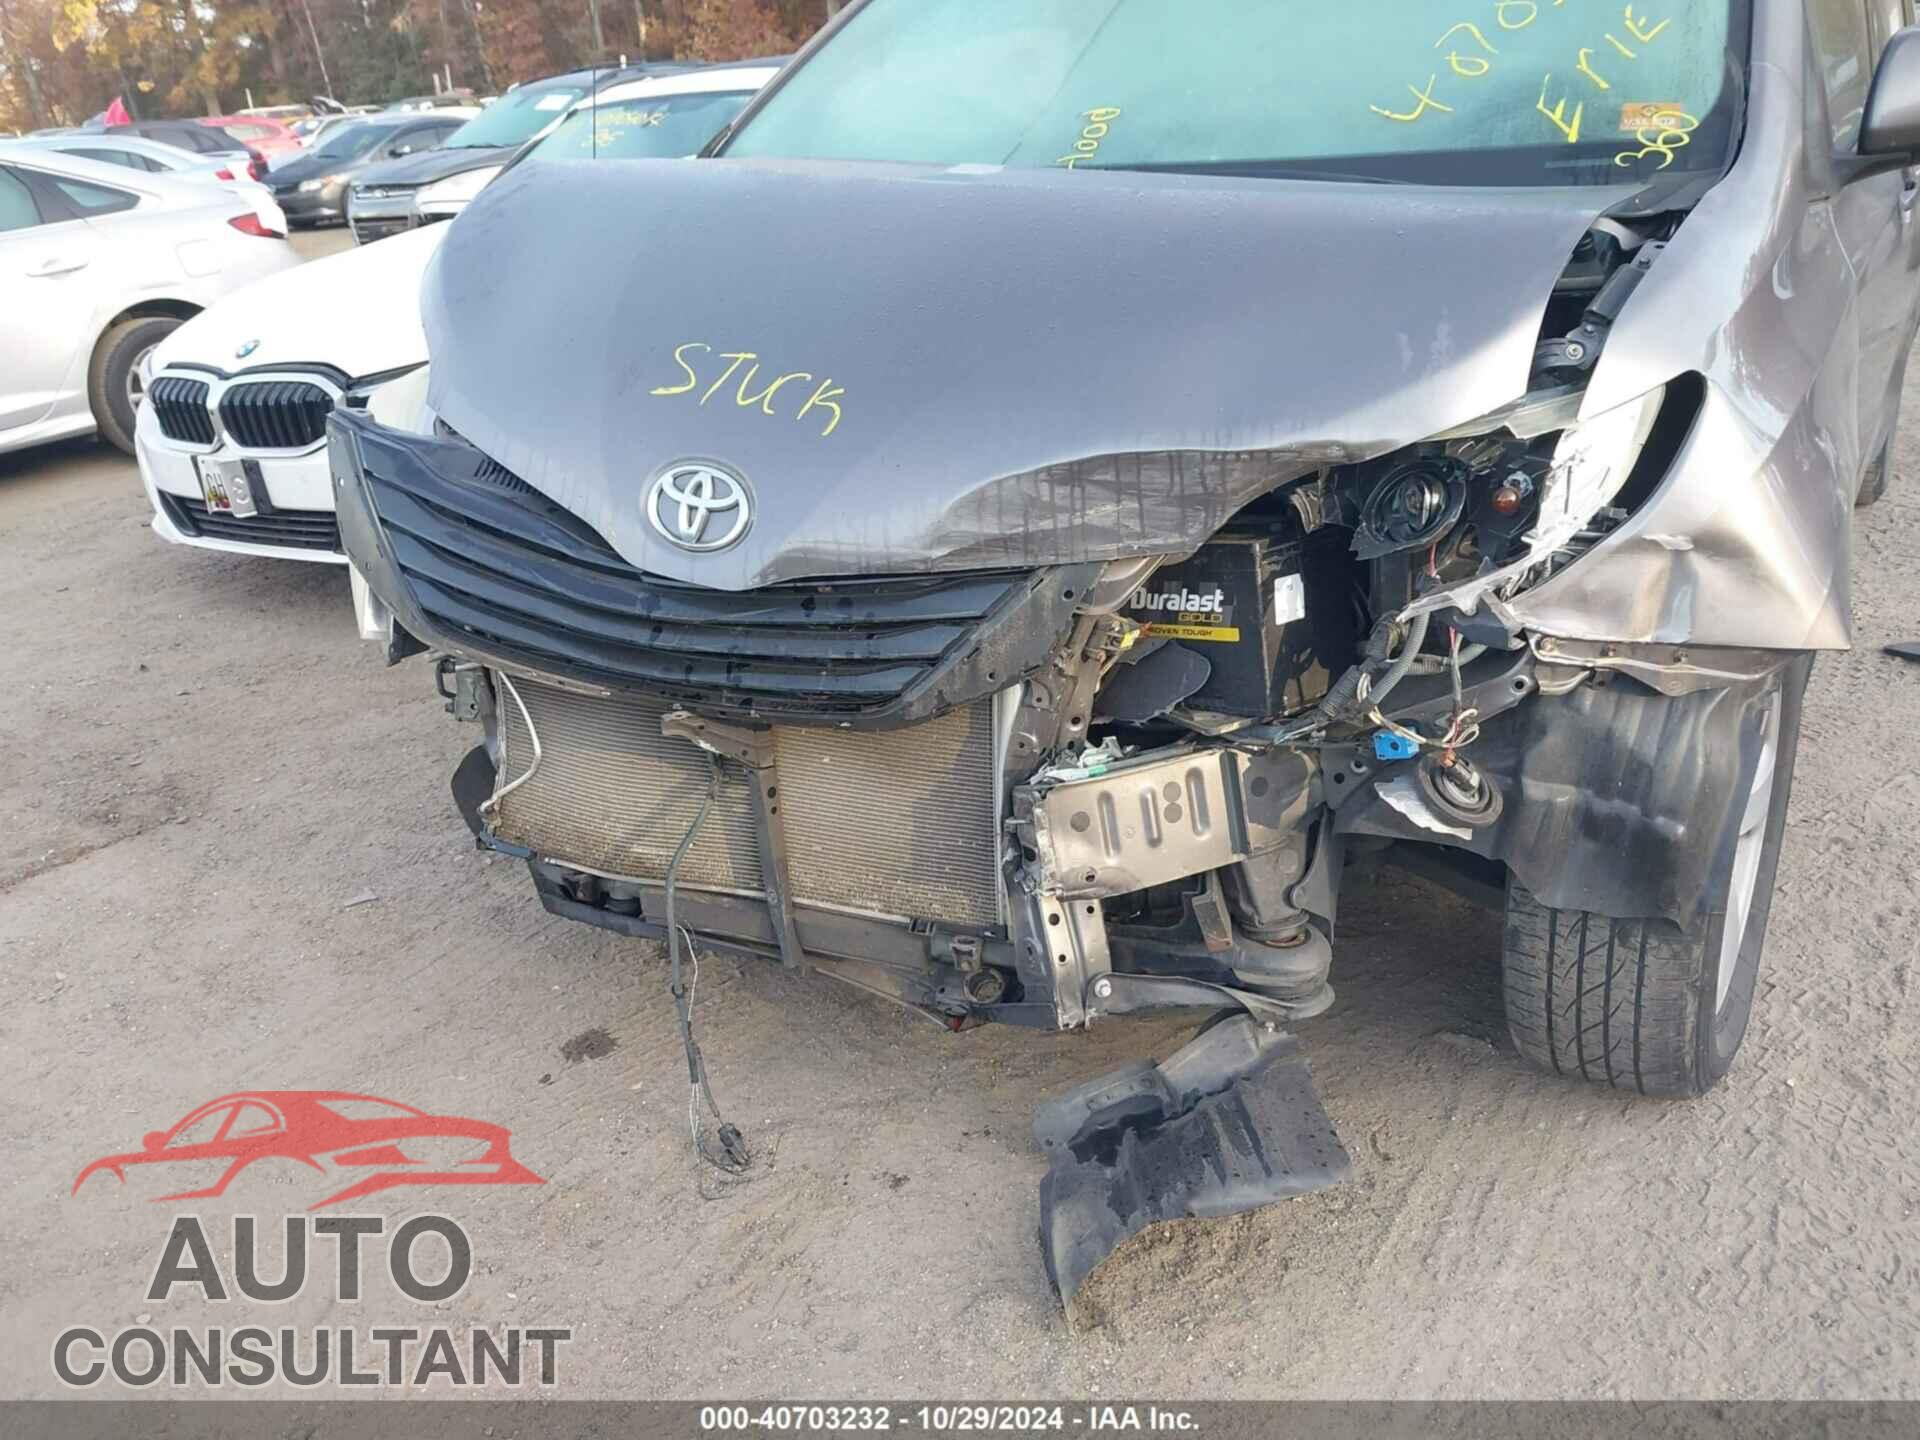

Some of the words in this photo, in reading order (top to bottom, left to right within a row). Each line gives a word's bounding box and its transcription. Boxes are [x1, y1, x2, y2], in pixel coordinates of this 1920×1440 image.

[1370, 0, 1564, 121] 4070
[649, 342, 846, 436] STUCK
[1131, 587, 1224, 613] Duralast
